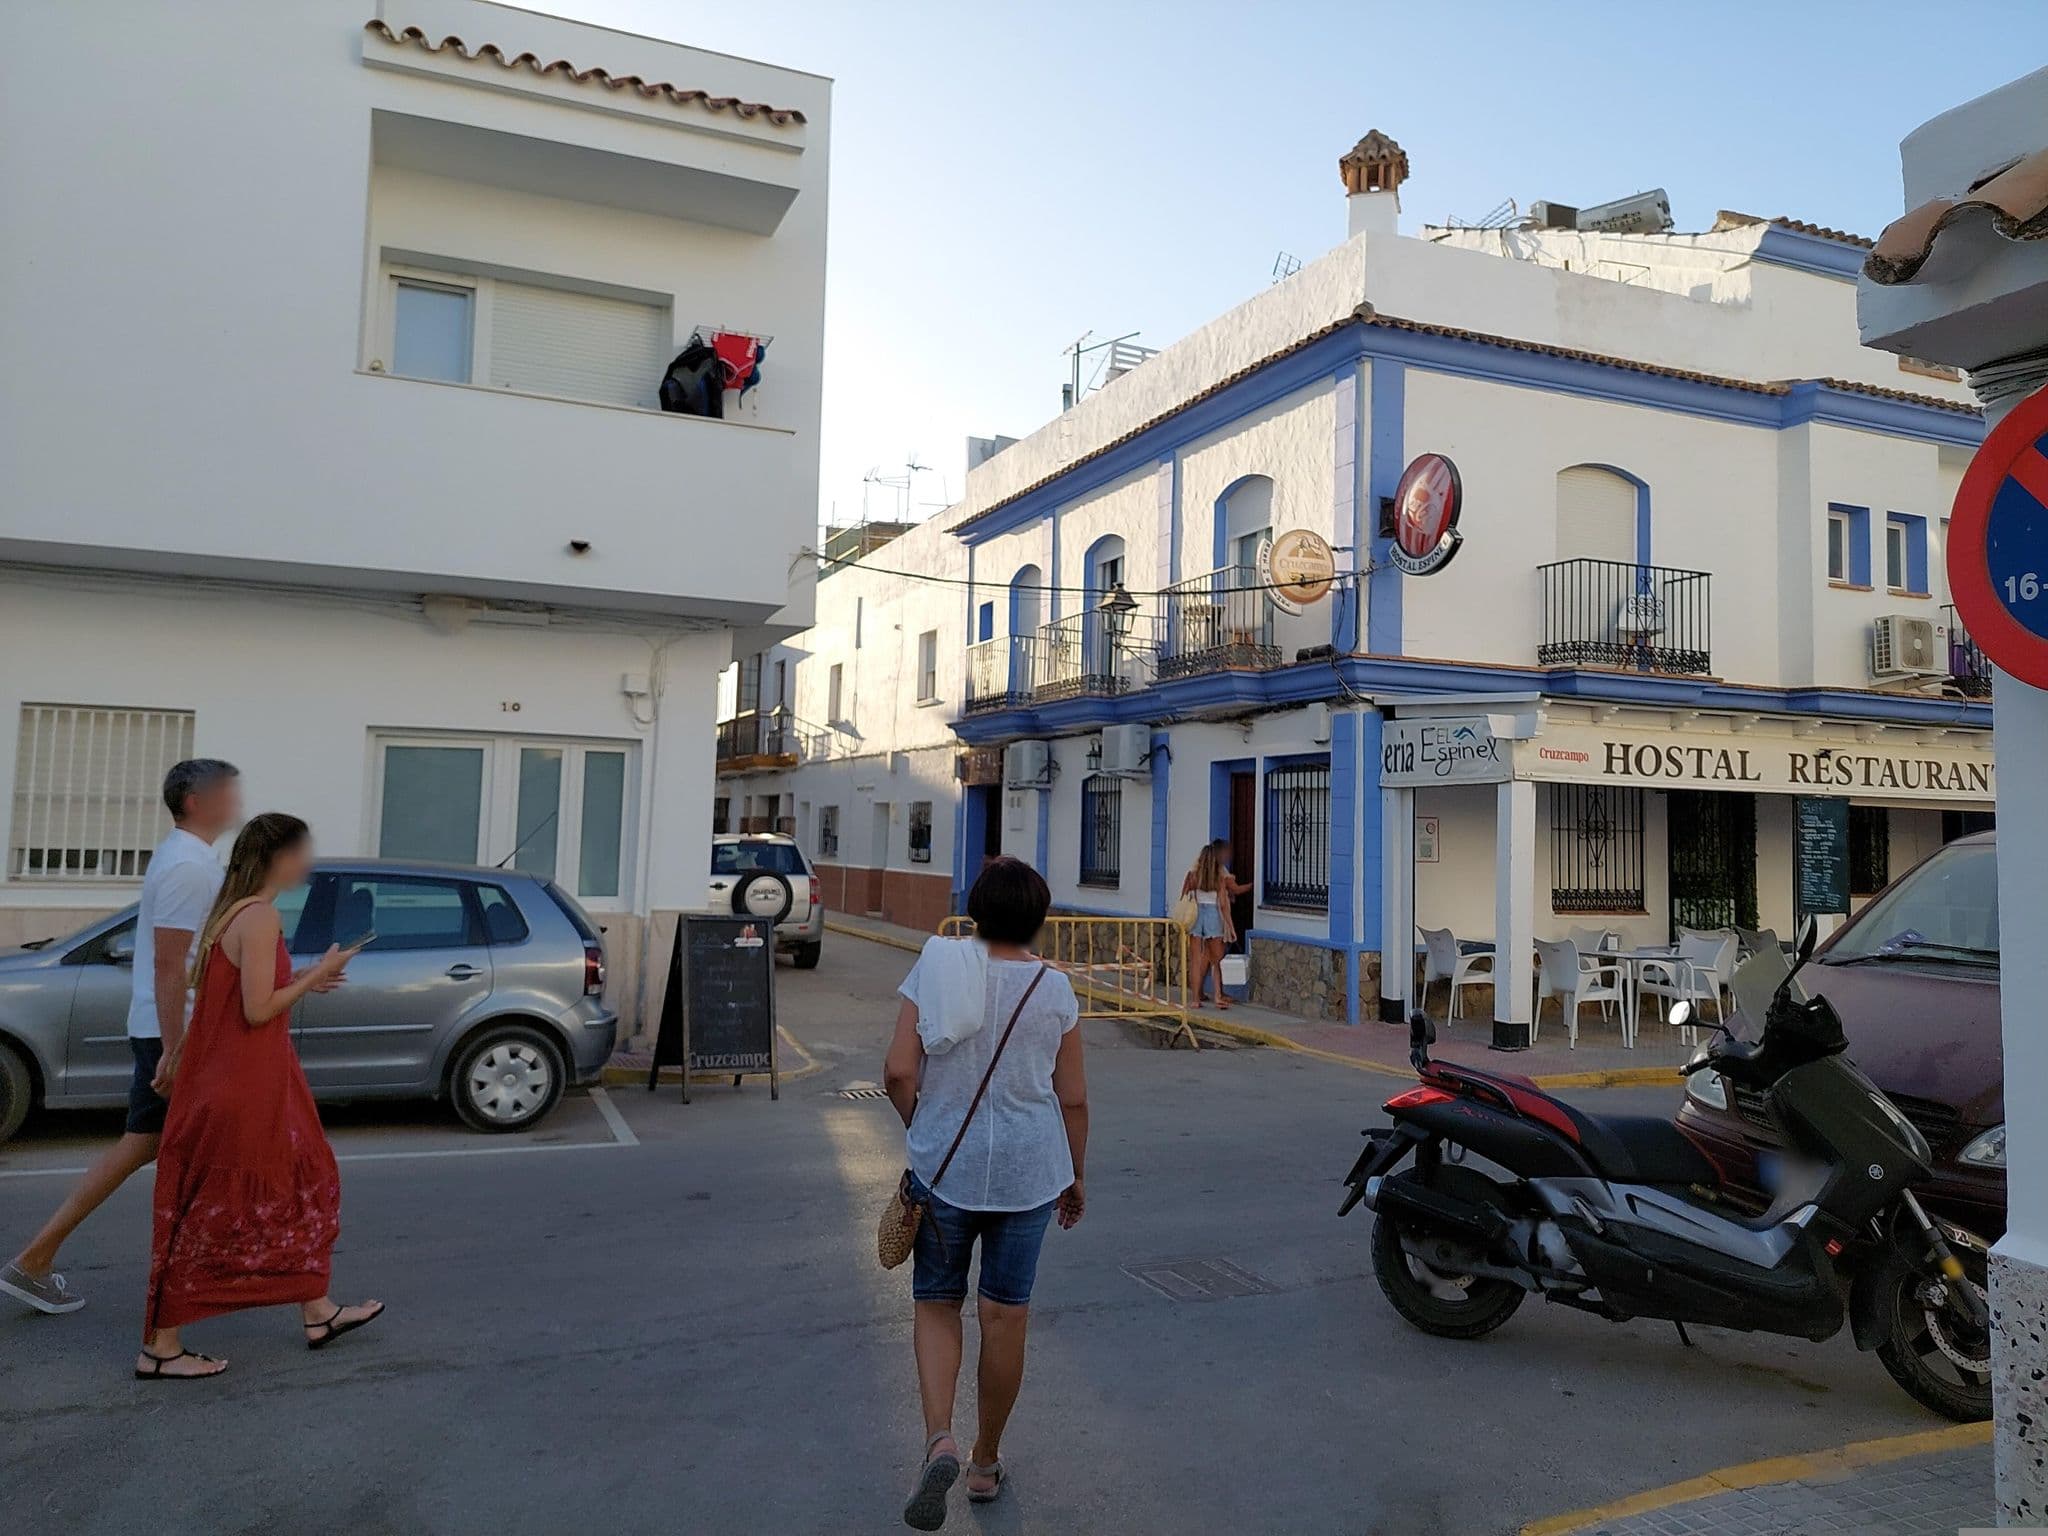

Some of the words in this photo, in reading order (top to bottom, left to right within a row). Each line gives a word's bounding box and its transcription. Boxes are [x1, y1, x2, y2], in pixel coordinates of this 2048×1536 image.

[502, 702, 521, 712] 10
[1538, 746, 1589, 764] Cruzcampo
[1602, 741, 1762, 782] HOSTAL
[1788, 751, 1995, 793] RESTAURAN
